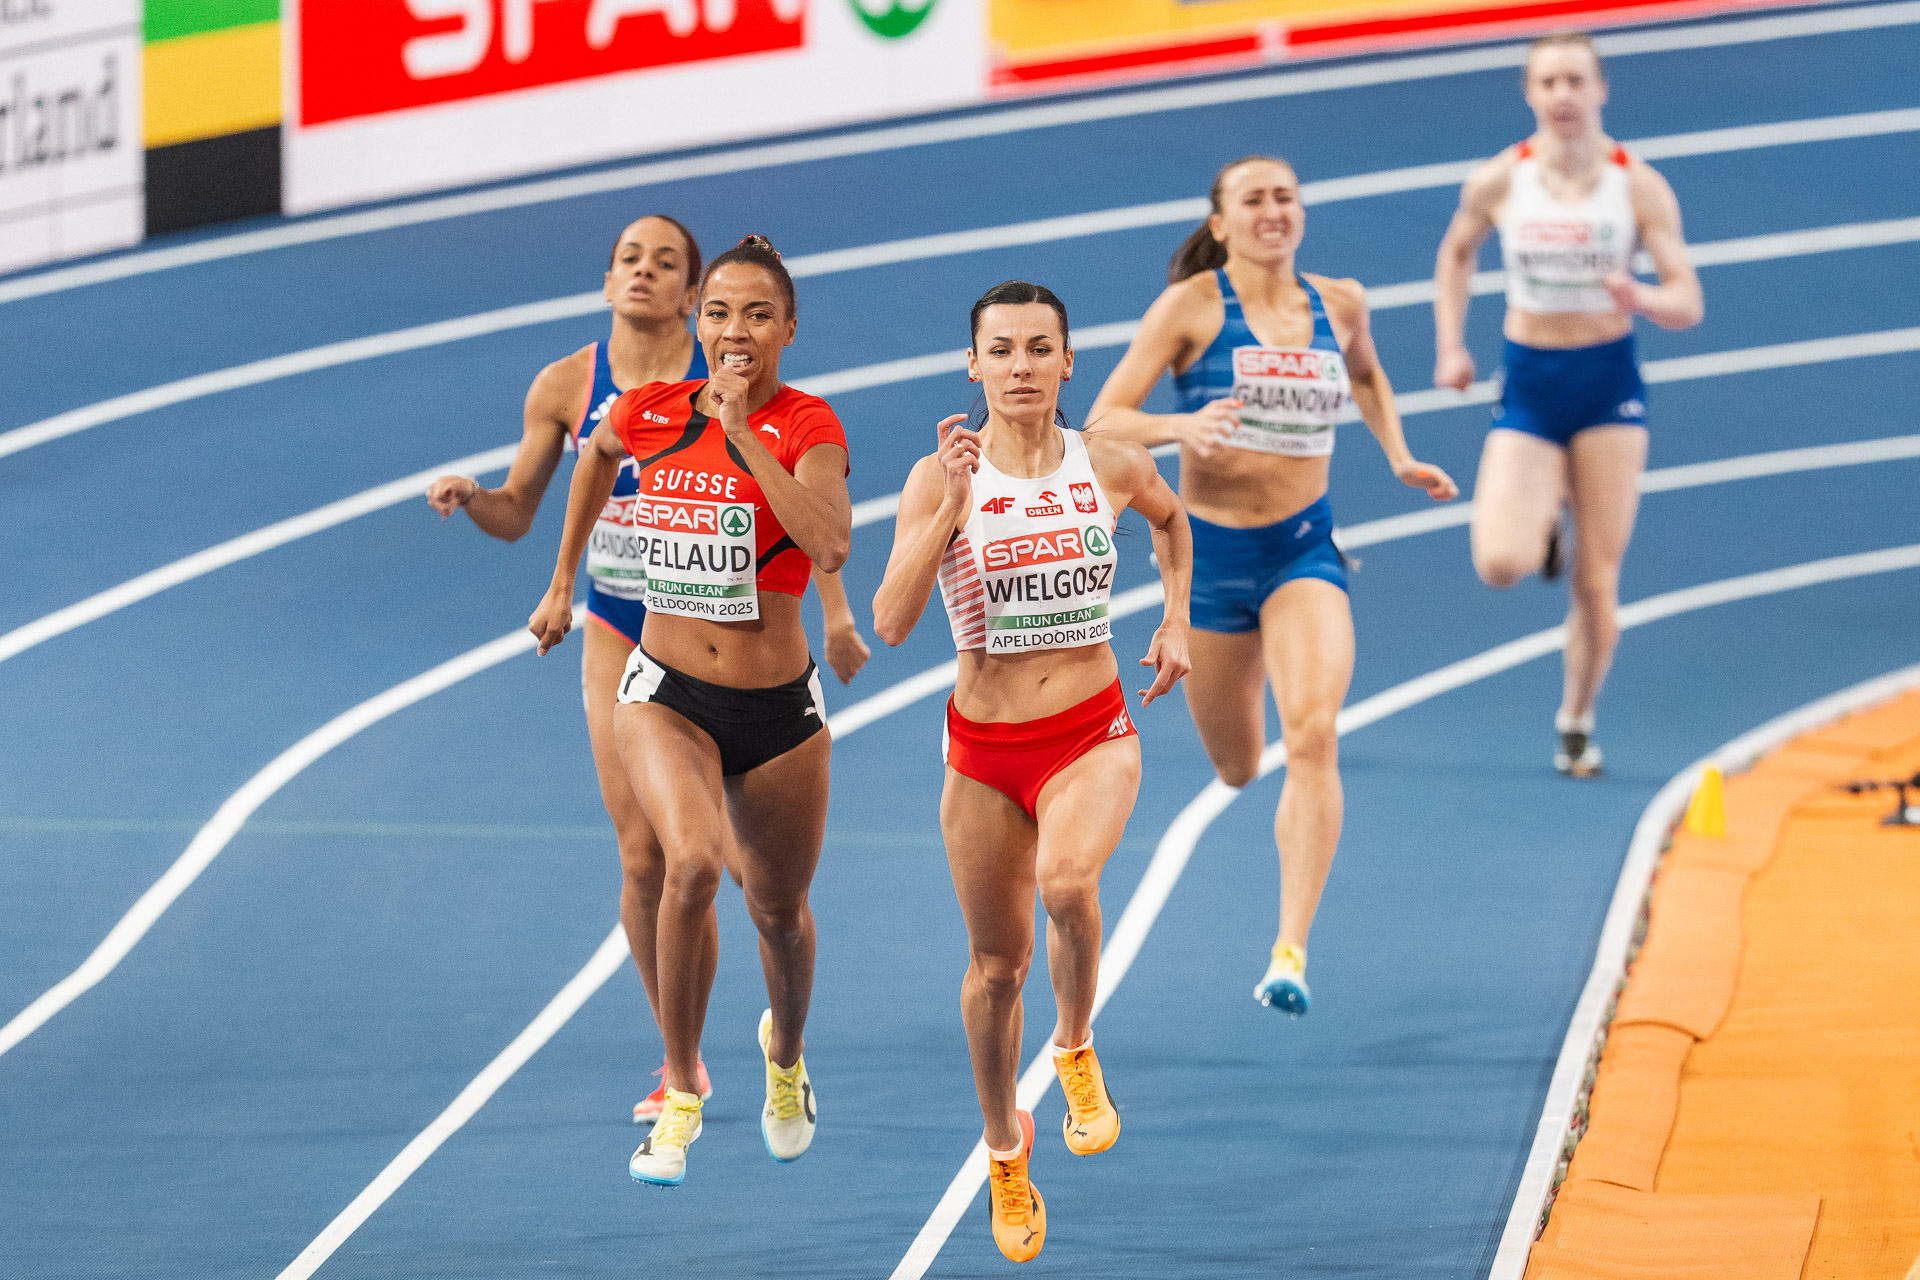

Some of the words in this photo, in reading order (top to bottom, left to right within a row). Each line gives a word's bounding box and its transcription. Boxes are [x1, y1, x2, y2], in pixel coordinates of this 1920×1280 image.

[1239, 352, 1319, 378] SPAR
[652, 414, 670, 425] UBS
[980, 497, 1016, 514] 4F
[1028, 506, 1061, 516] ORLEN
[637, 502, 716, 531] SPAR
[638, 535, 751, 573] PELLAUD
[985, 532, 1081, 567] SPAR
[659, 580, 682, 594] RUN
[986, 563, 1113, 604] WIELGOSZ
[719, 602, 754, 616] 2025
[1022, 614, 1051, 627] RUN
[992, 628, 1087, 648] APELDOORN
